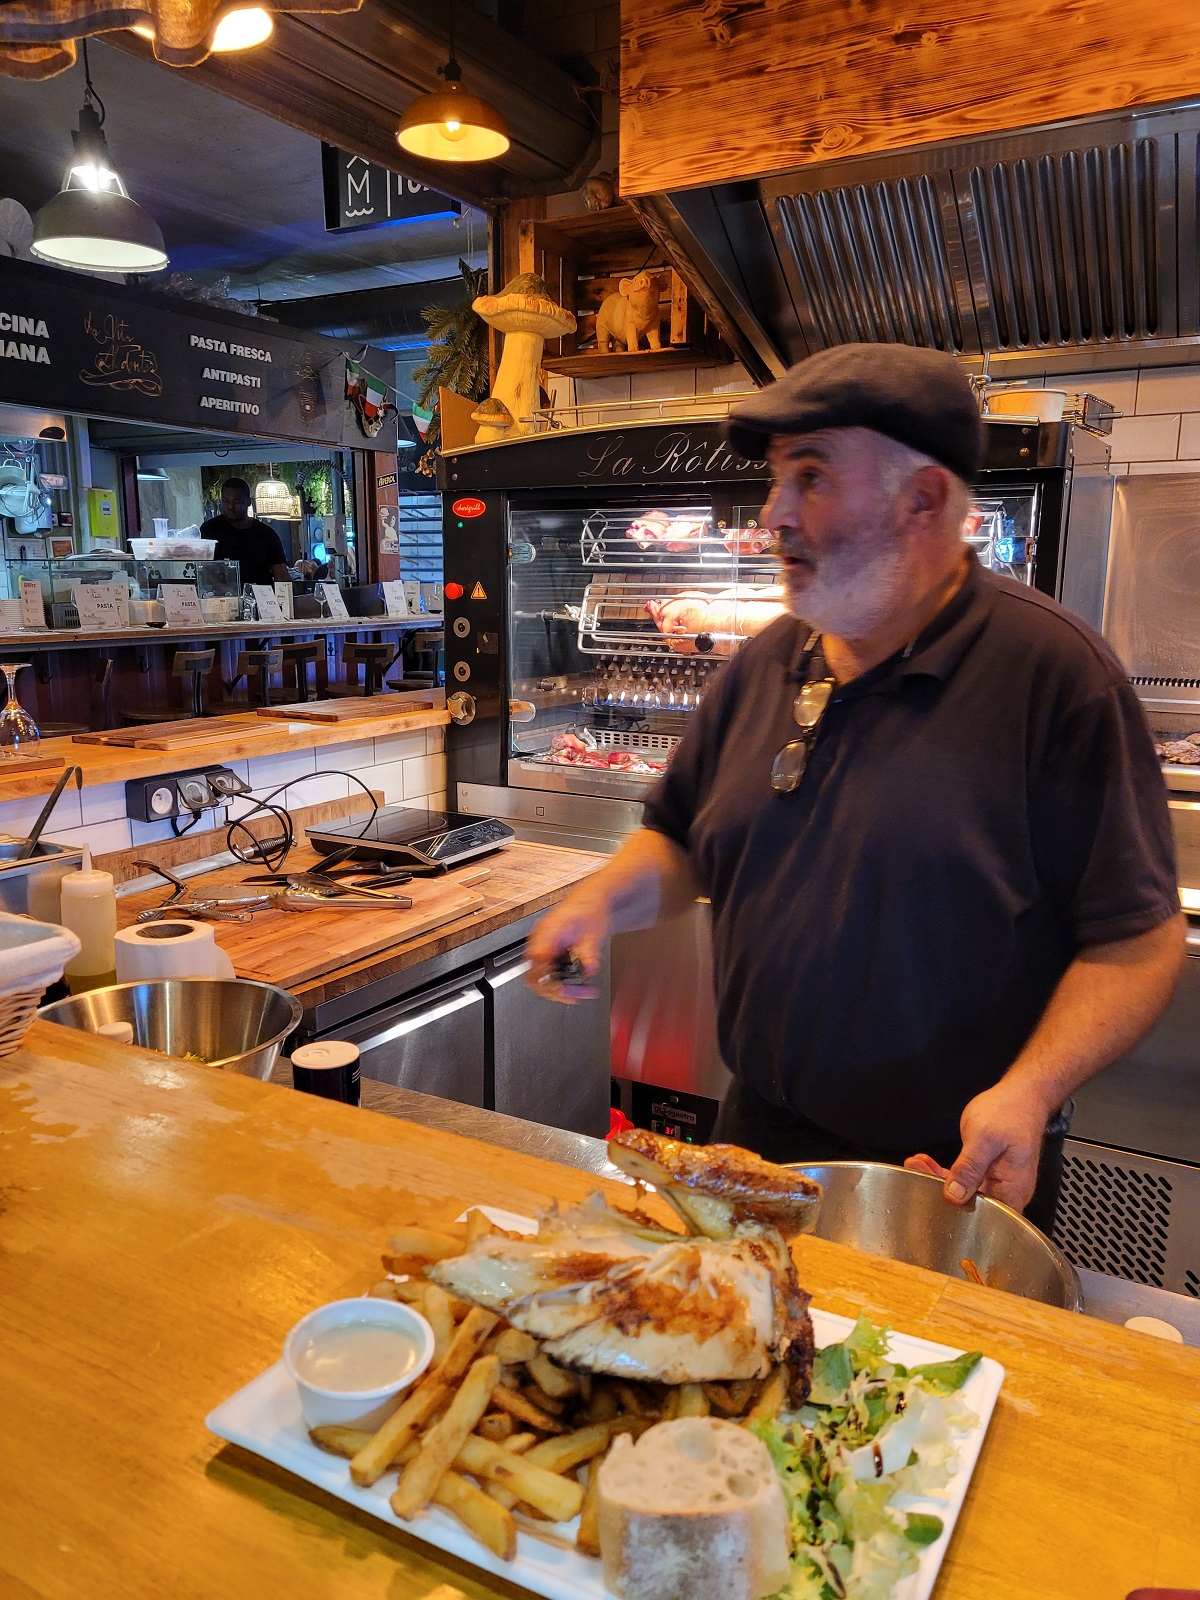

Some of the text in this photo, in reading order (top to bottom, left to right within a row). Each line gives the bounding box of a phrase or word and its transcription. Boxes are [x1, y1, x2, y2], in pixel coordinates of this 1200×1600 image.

[0, 312, 50, 338] CINA
[190, 335, 272, 362] PASTA FRESCA
[202, 367, 261, 388] ANTIPASTI
[200, 396, 260, 415] APERITIVO
[577, 436, 637, 478] La
